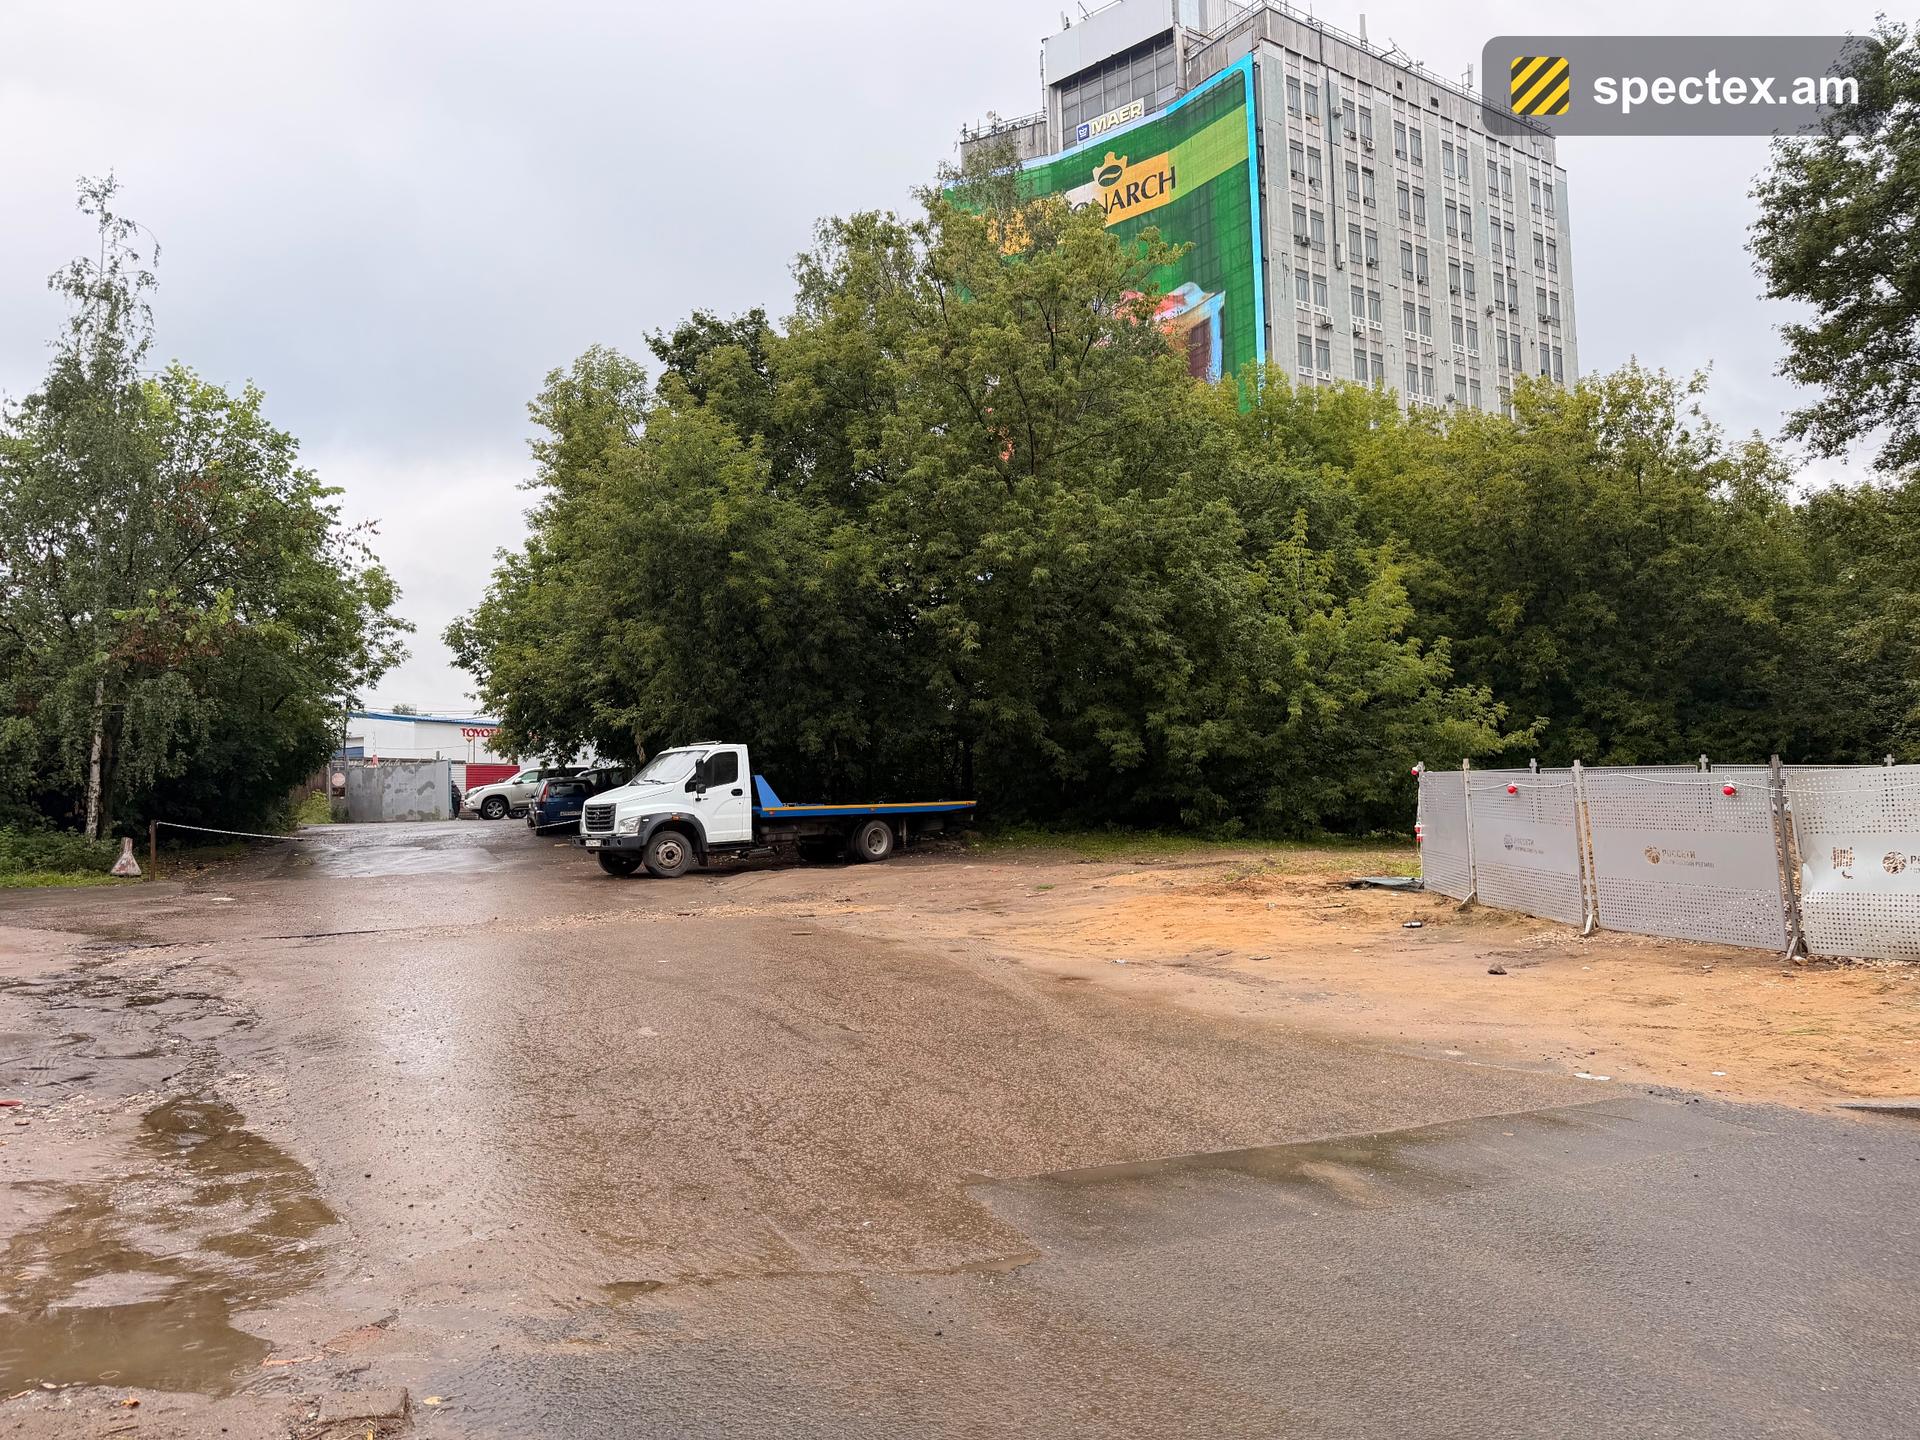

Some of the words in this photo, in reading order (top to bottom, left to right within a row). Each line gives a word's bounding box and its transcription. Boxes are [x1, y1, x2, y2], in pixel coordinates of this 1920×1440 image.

[1091, 103, 1142, 135] MAER
[1073, 165, 1176, 214] NARCH
[461, 727, 501, 738] TOYO
